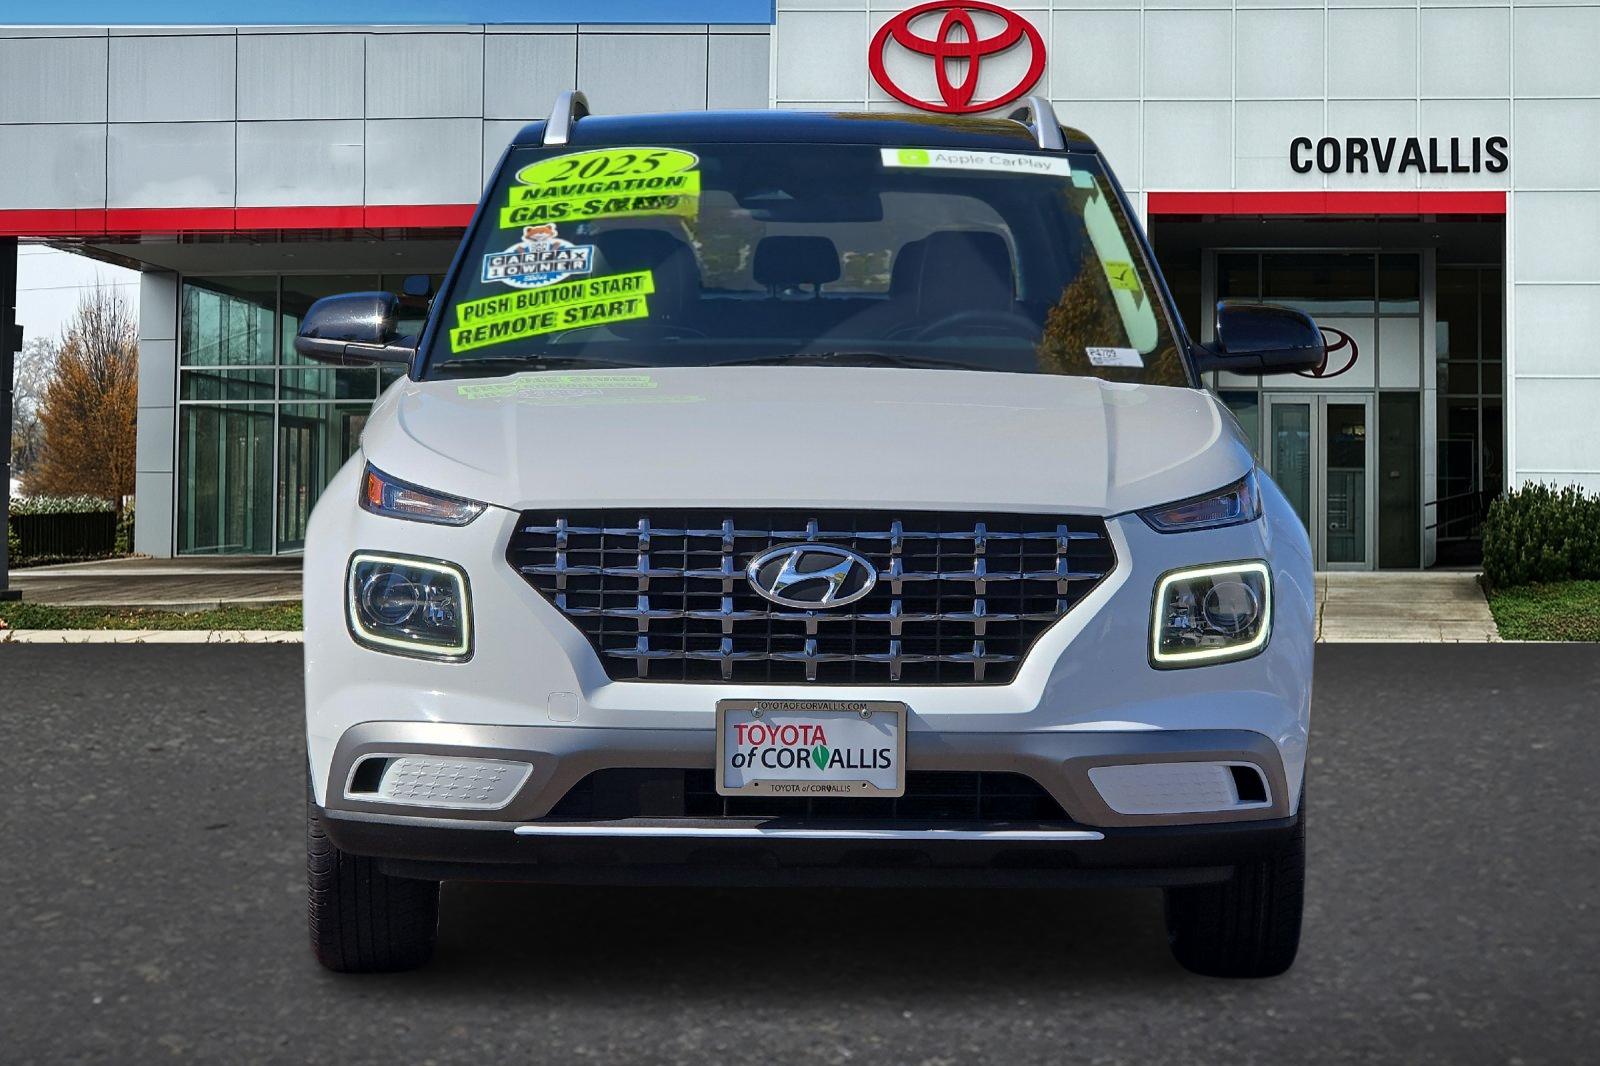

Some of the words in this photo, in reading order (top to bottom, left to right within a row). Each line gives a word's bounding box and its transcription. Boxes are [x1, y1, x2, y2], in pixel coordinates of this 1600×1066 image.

[935, 153, 984, 165] Apple
[989, 155, 1052, 170] CarPlay
[1290, 136, 1509, 174] CORVALLIS
[547, 152, 669, 183] 2025
[521, 175, 685, 200] NAVIGATION
[509, 195, 680, 223] GAS-S
[491, 250, 586, 267] CARFAX
[505, 261, 585, 276] OWNER
[463, 301, 511, 321] PUSH
[516, 285, 583, 309] BUTTON
[590, 275, 643, 296] START
[457, 312, 558, 346] REMOTE
[563, 299, 638, 324] START
[757, 702, 867, 711] TOYOTAOFCORVALLIS.COM
[733, 724, 828, 746] TOYOTA
[731, 747, 758, 769] of
[802, 784, 810, 792] of
